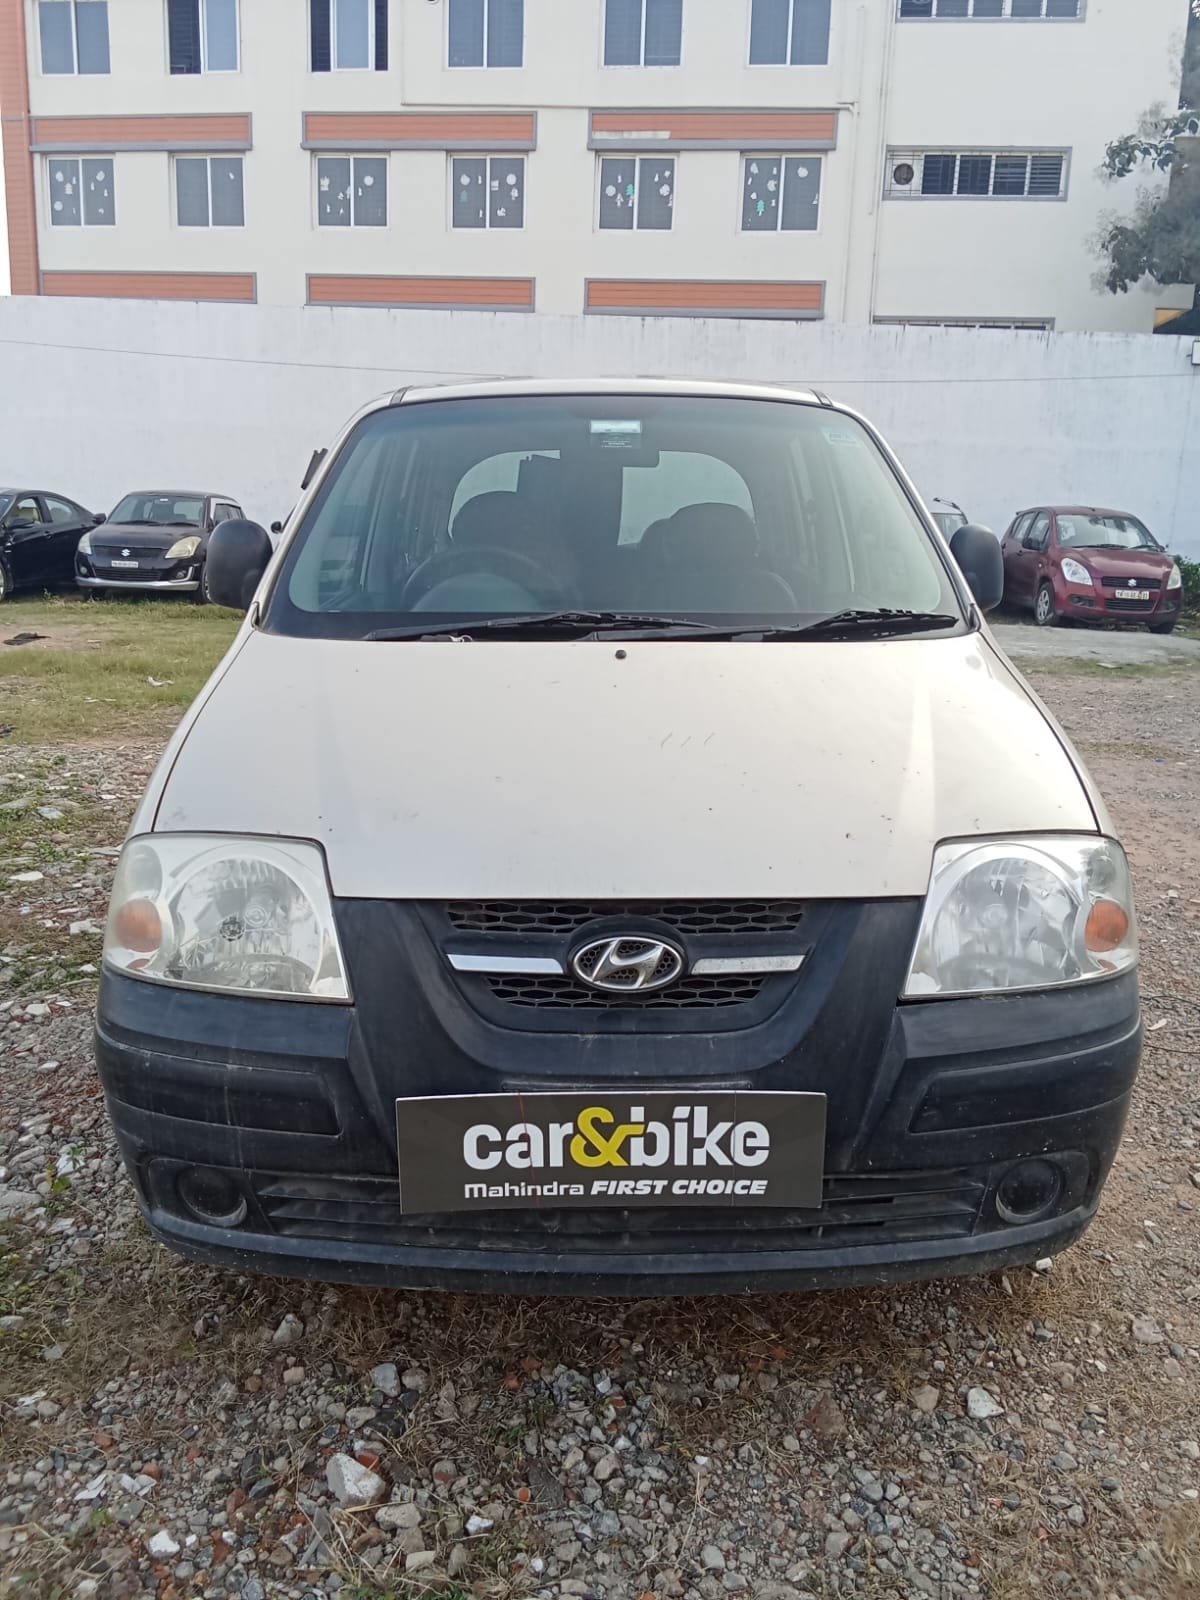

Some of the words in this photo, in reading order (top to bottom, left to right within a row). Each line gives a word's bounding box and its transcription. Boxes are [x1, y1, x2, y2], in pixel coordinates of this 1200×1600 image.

[463, 1106, 770, 1170] car&bike
[464, 1181, 584, 1198] Mahindra
[590, 1180, 668, 1196] FIRST
[671, 1179, 768, 1196] CHOICE
